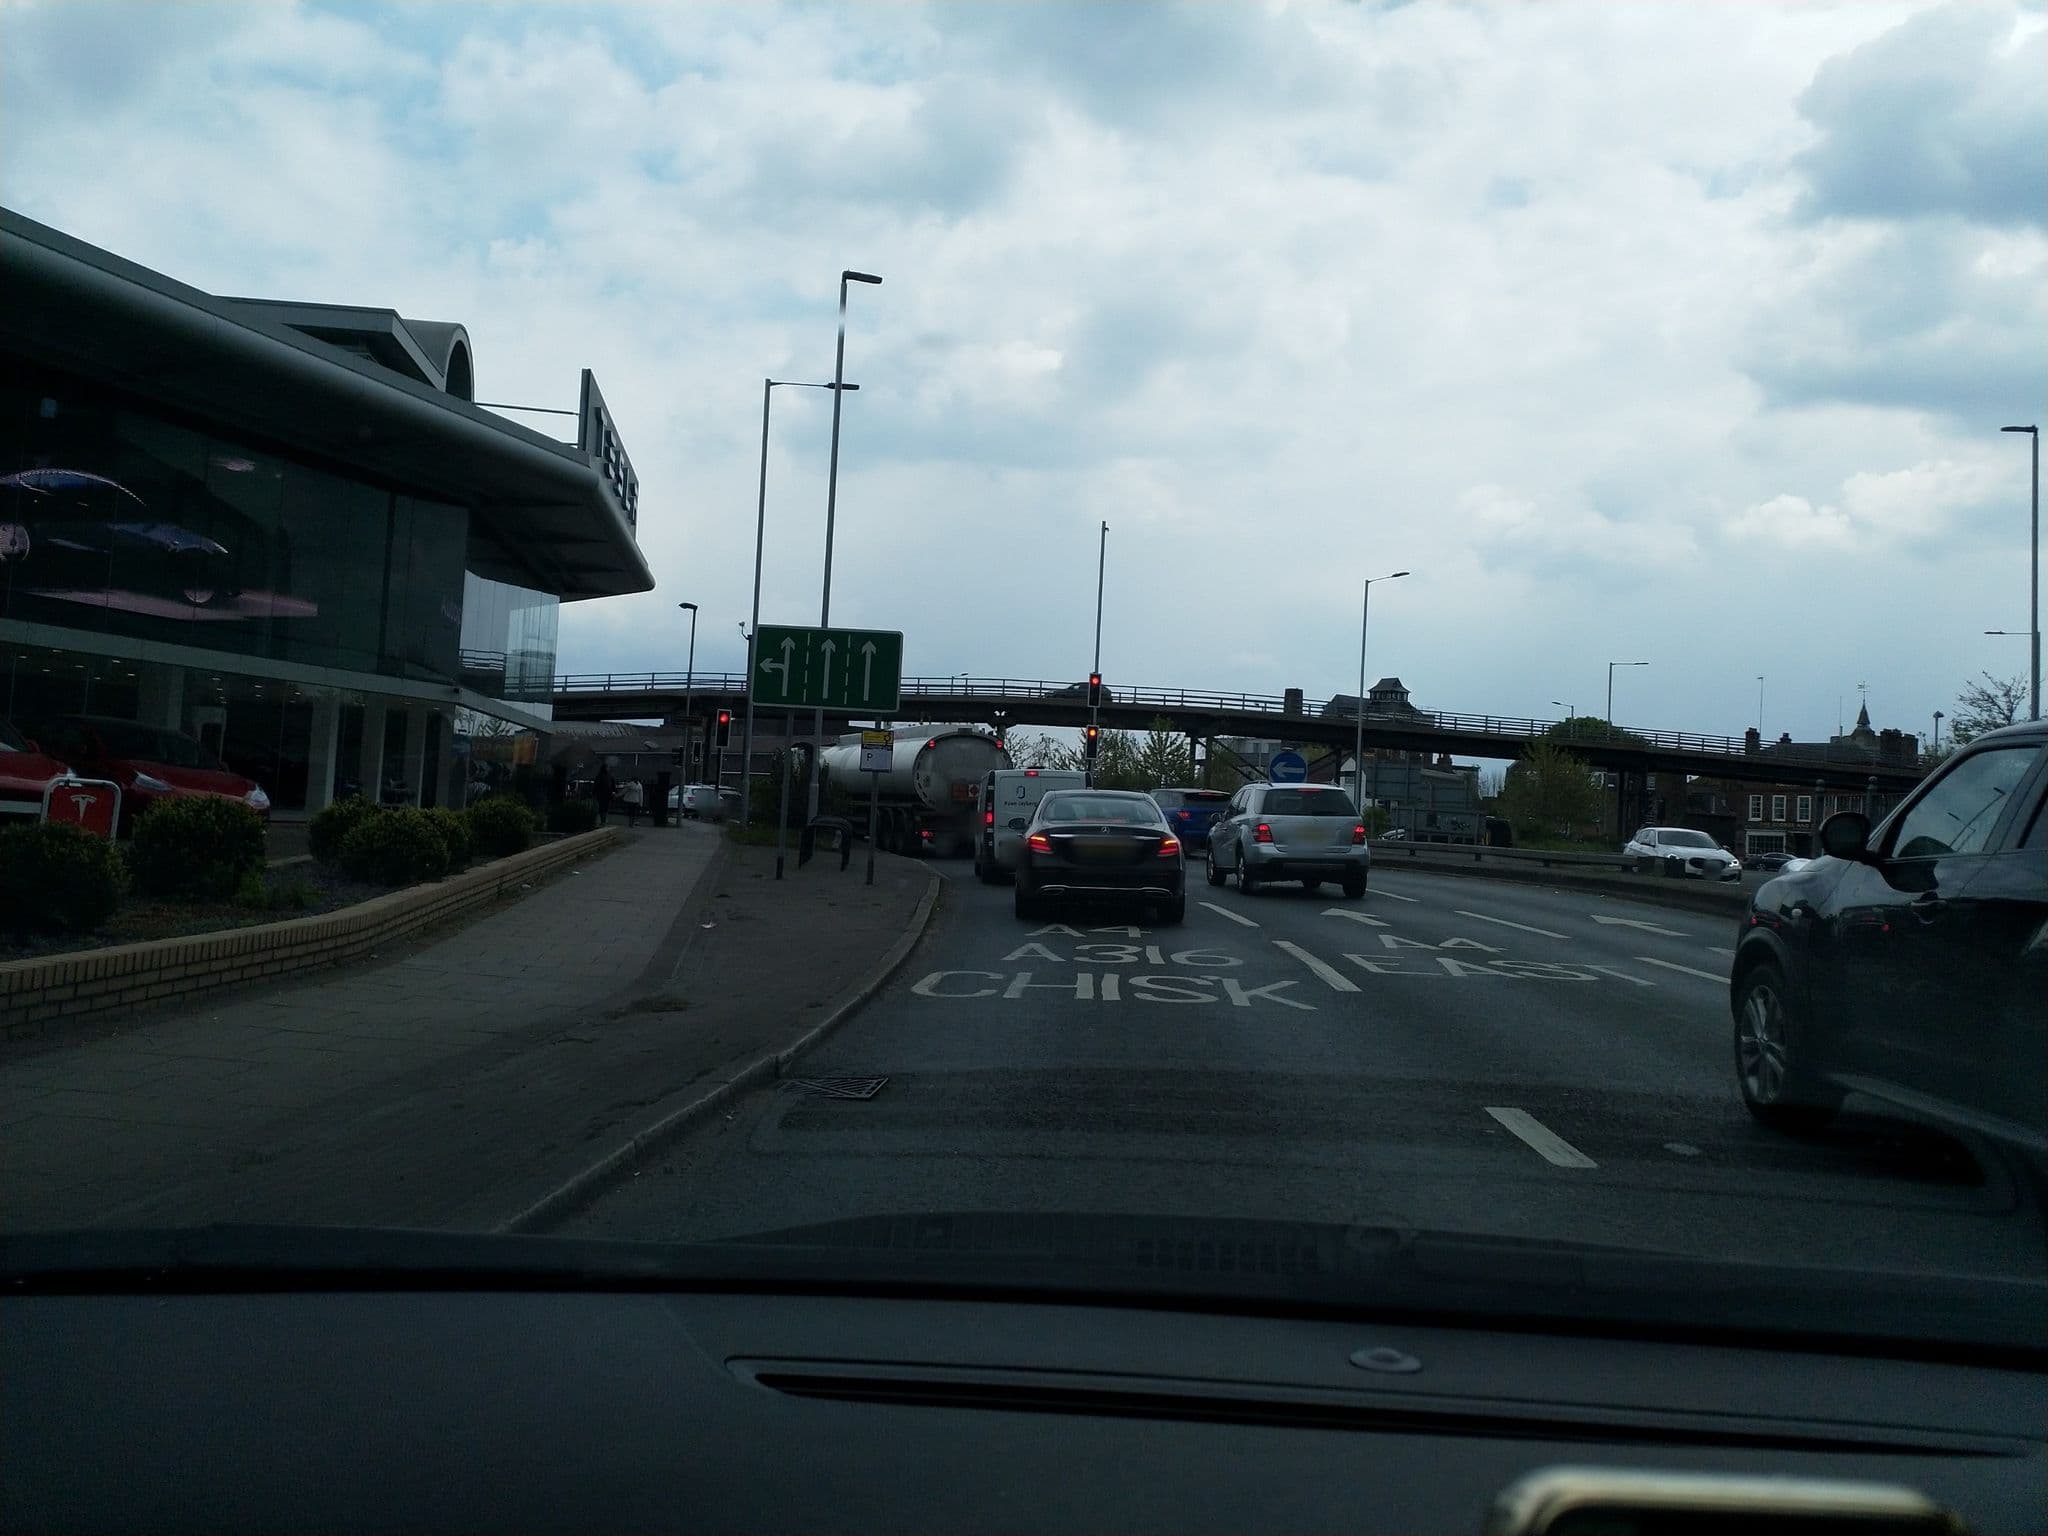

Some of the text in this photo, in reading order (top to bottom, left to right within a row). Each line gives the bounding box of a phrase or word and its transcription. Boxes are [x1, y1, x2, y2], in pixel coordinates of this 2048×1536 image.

[1024, 923, 1153, 938] A4
[1002, 942, 1244, 967] A316
[1342, 953, 1657, 985] EAST
